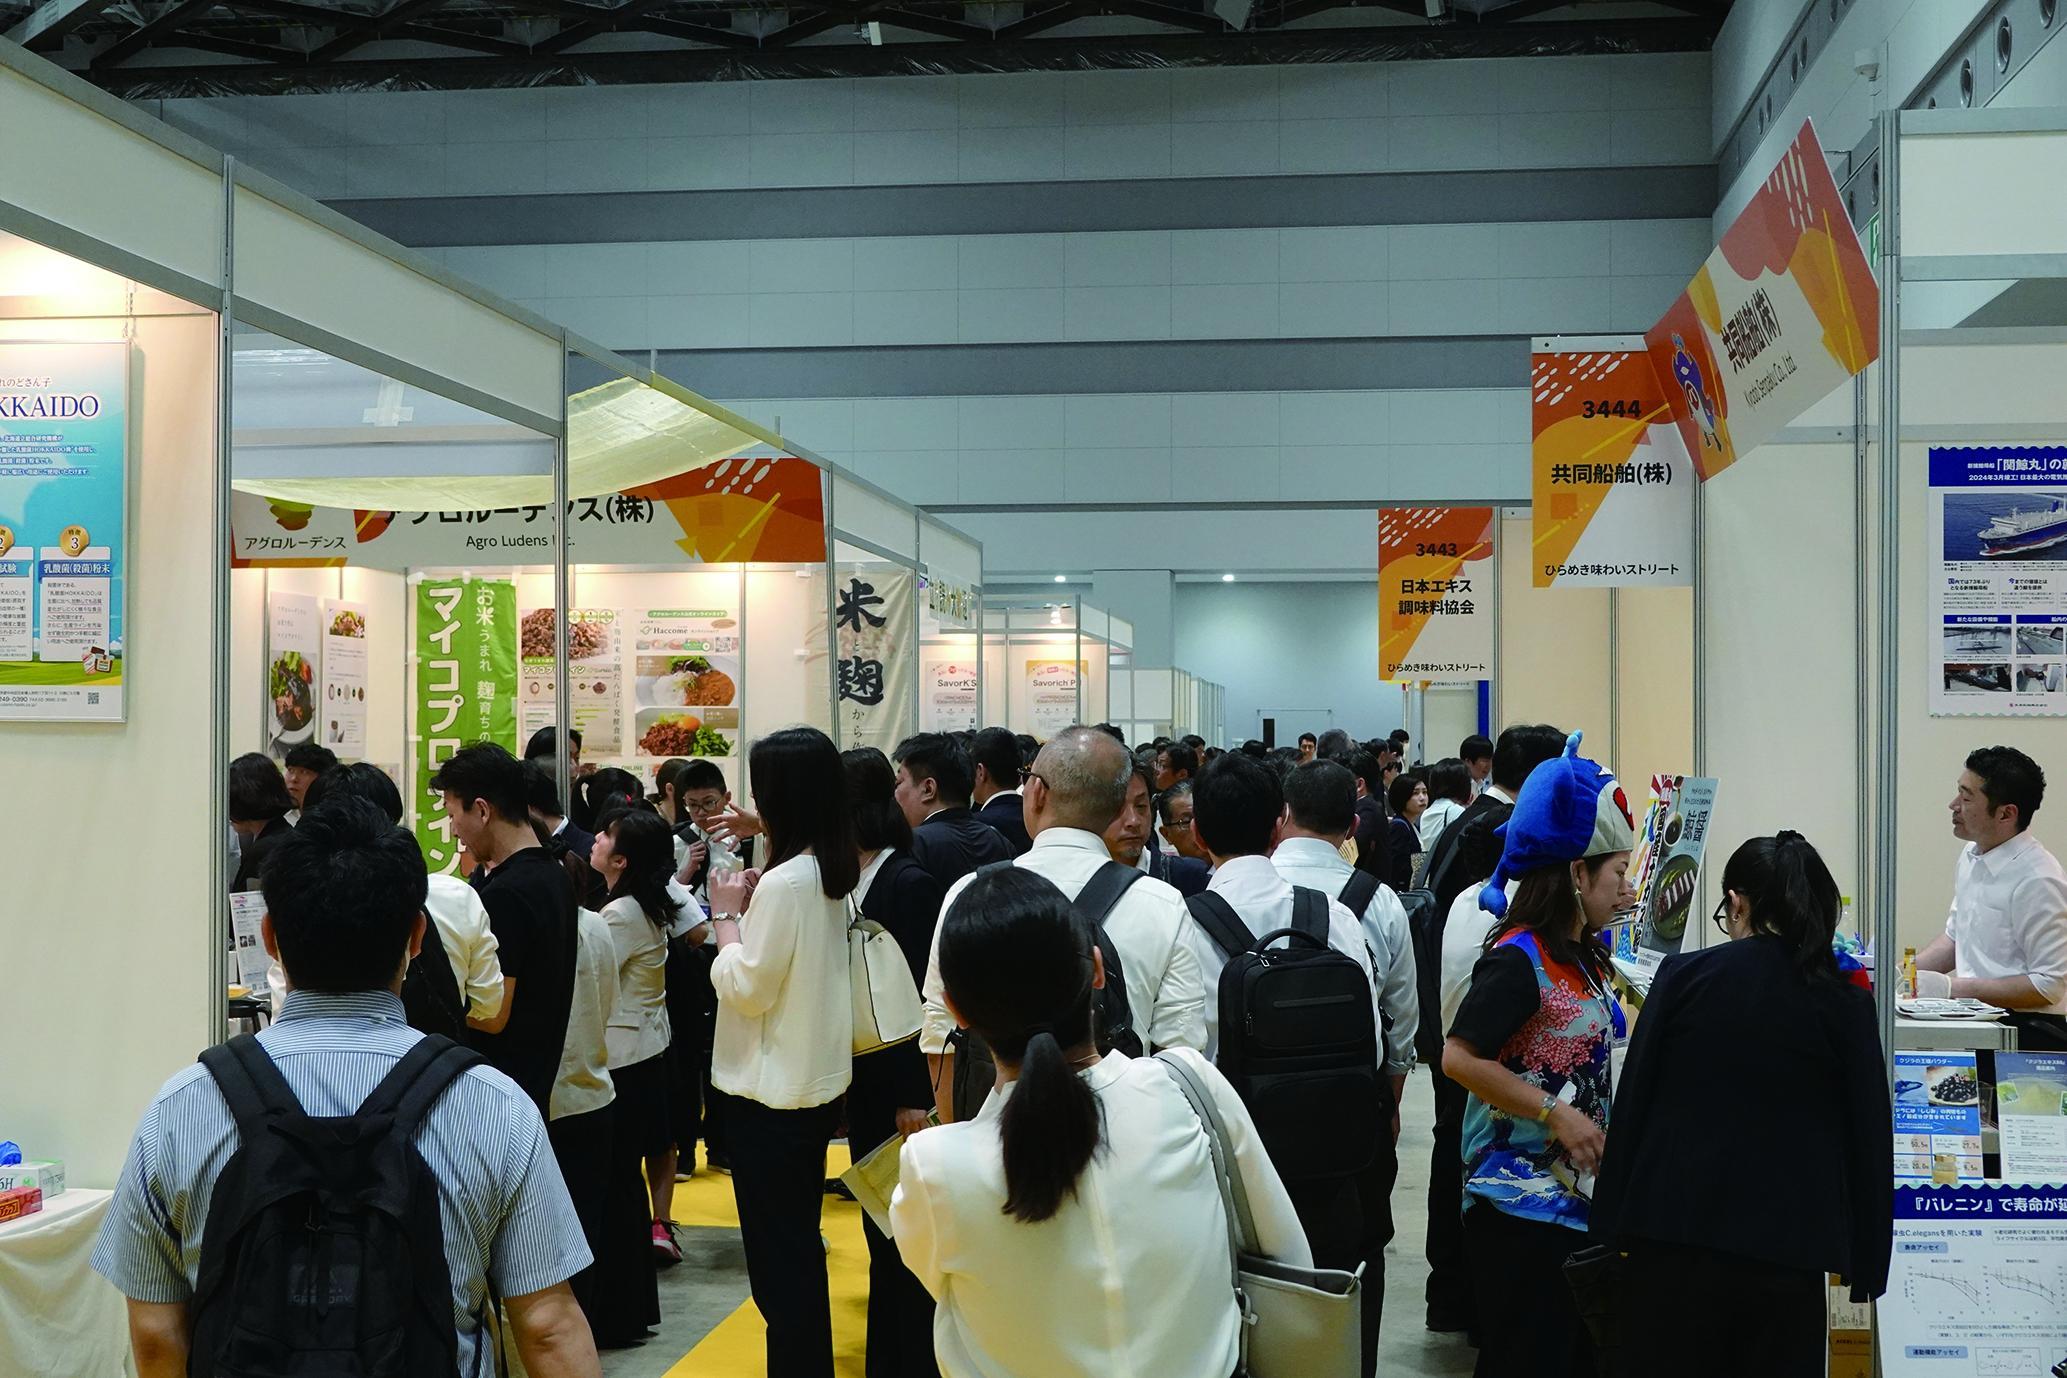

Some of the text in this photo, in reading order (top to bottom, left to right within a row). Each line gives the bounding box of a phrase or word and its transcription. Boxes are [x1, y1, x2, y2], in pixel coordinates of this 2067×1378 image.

[1720, 287, 1782, 375] 共同船舶(株)
[1582, 400, 1641, 419] 3444
[1551, 462, 1672, 485] 共同船舶(株)
[71, 537, 79, 549] 3
[245, 536, 346, 551] アグロルーデンス
[466, 535, 498, 550] Agro
[501, 534, 548, 547] Ludens
[1416, 543, 1457, 556] 3443
[1545, 564, 1679, 576] ひらめき味わいストリート
[1401, 579, 1473, 594] 日本エキス
[1398, 600, 1475, 615] 調味料協会
[1387, 663, 1486, 673] ひらめき味わいストリート
